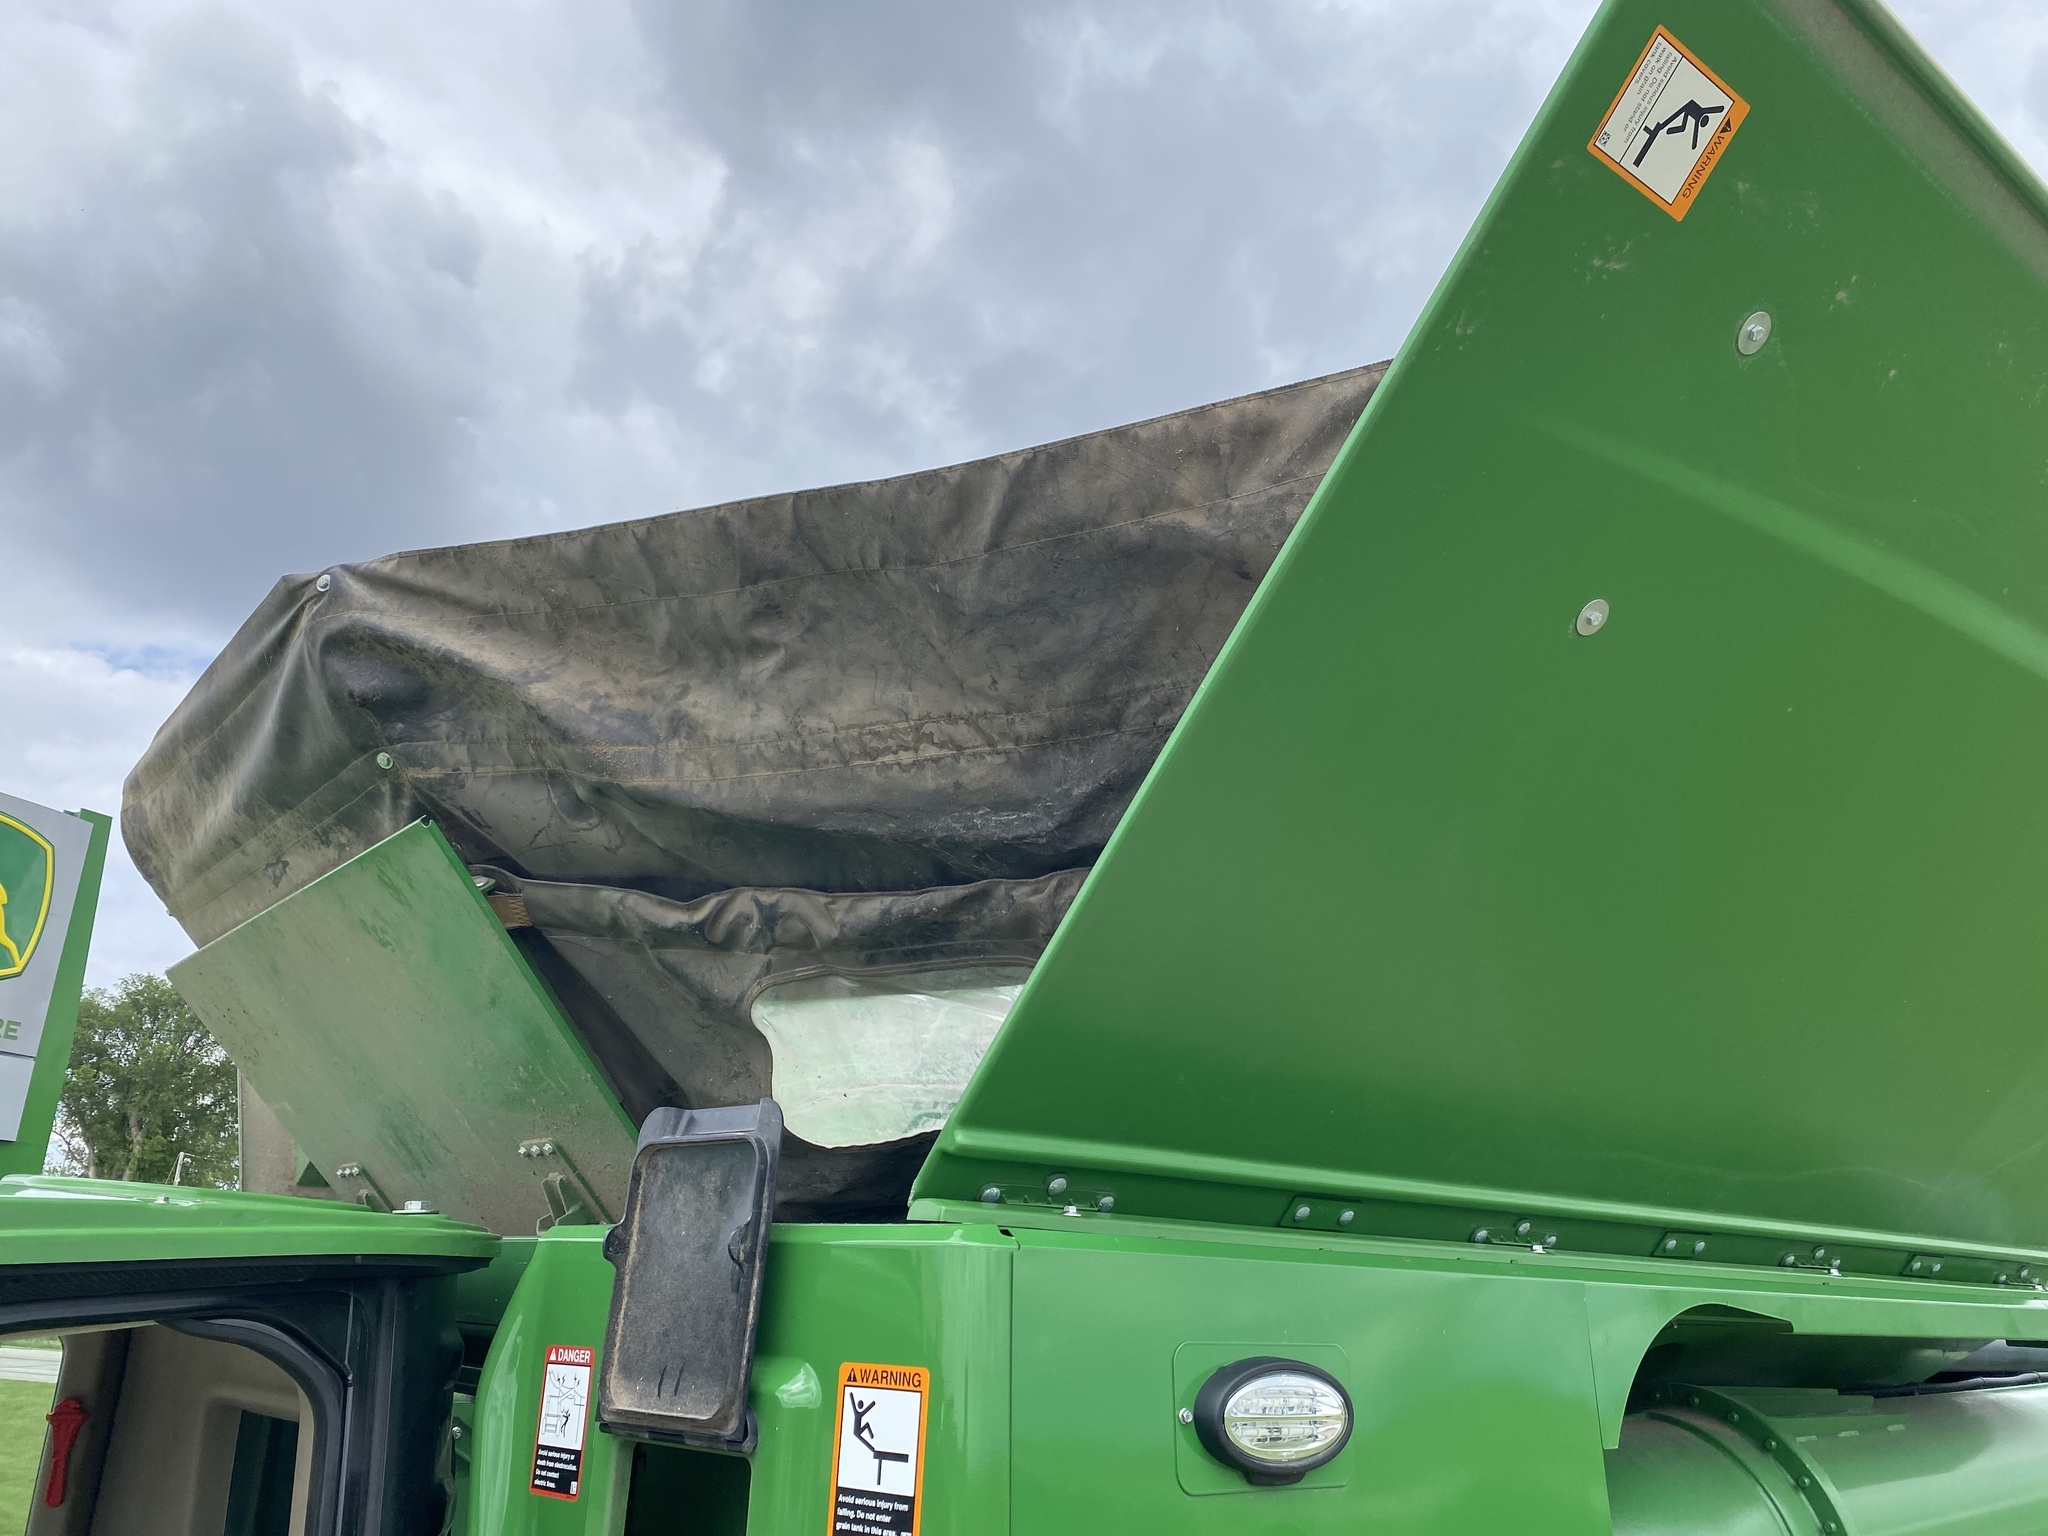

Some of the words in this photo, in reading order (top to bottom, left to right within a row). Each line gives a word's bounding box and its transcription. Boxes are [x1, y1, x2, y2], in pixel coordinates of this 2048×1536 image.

[1651, 41, 1662, 59] tank
[1655, 47, 1667, 64] walk
[1648, 64, 1656, 76] on
[1663, 56, 1678, 78] Avoid
[1636, 75, 1650, 95] grain
[1649, 77, 1658, 86] Do
[1640, 89, 1650, 102] not
[1647, 78, 1665, 105] serious
[1628, 103, 1642, 121] stand
[1634, 106, 1649, 126] injury
[1623, 124, 1630, 133] or
[1624, 126, 1636, 144] from
[1682, 135, 1725, 198] WARNING
[557, 1348, 591, 1363] DANGER
[860, 1368, 922, 1388] WARNING
[837, 1493, 855, 1504] Avoid
[855, 1497, 876, 1507] serious
[876, 1499, 893, 1511] injury
[894, 1502, 909, 1512] from
[856, 1510, 865, 1519] Do
[865, 1512, 876, 1521] not
[876, 1514, 892, 1523] enter
[835, 1521, 851, 1531] grain
